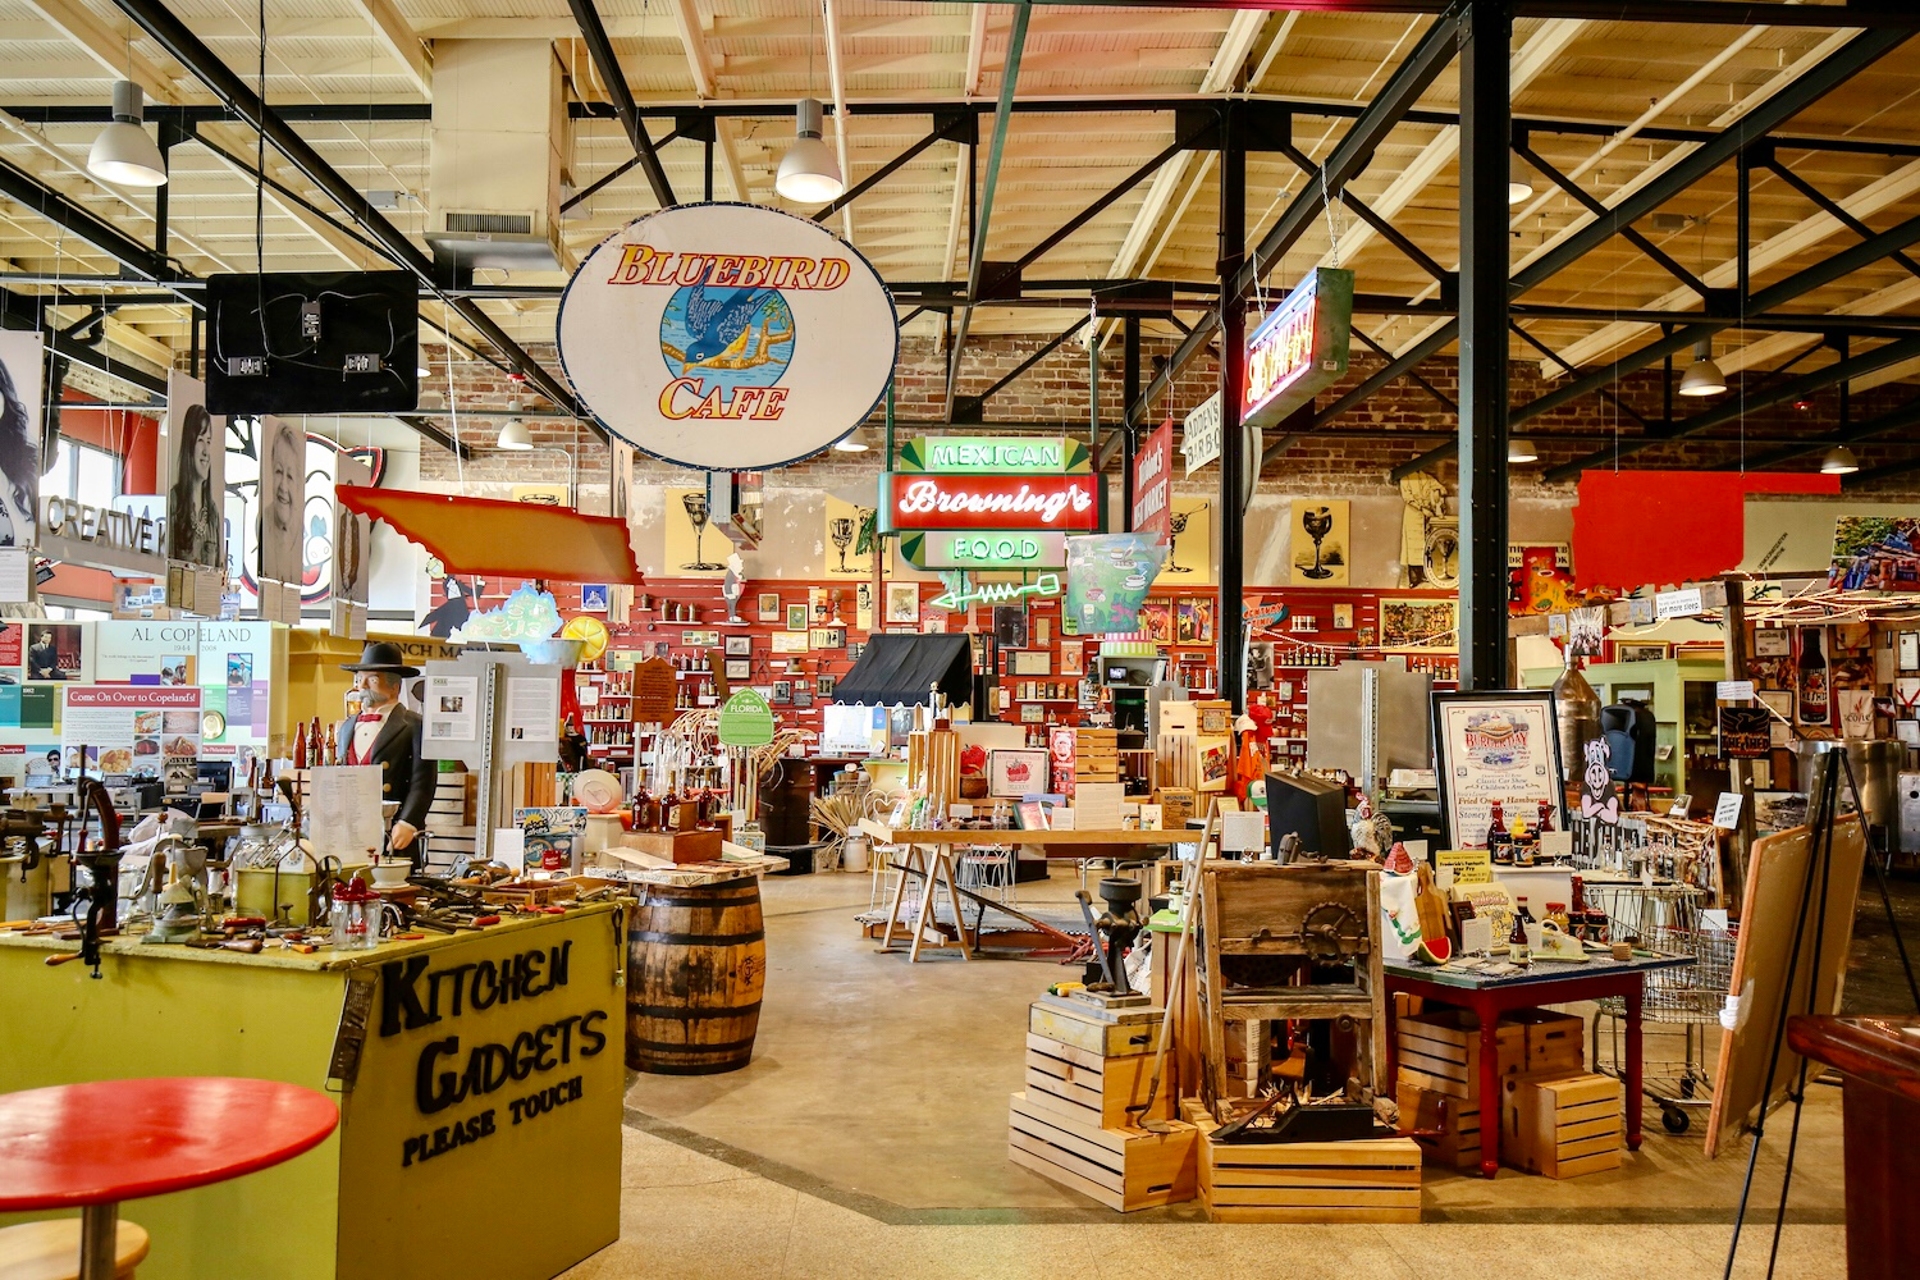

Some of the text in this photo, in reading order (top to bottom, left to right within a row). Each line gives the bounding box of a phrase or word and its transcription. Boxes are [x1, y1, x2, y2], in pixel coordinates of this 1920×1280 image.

[608, 243, 851, 290] BLUEBIRD
[658, 376, 789, 421] CAFE
[932, 445, 1060, 466] MEXICAN
[899, 480, 1093, 523] Browning's
[47, 495, 153, 554] CREATIVE
[953, 538, 1039, 560] FOOD
[1659, 606, 1668, 616] get
[1669, 604, 1682, 612] more
[131, 627, 252, 642] AL COPELAND
[363, 640, 433, 657] FNCH
[70, 691, 196, 705] Come On Over to Copeland's!
[730, 704, 763, 713] FLORIDA
[1458, 796, 1478, 805] Fried
[379, 940, 573, 1038] KITCHEN
[416, 1010, 608, 1115] GADGETS
[402, 1076, 584, 1168] PLEASE TOUCH
